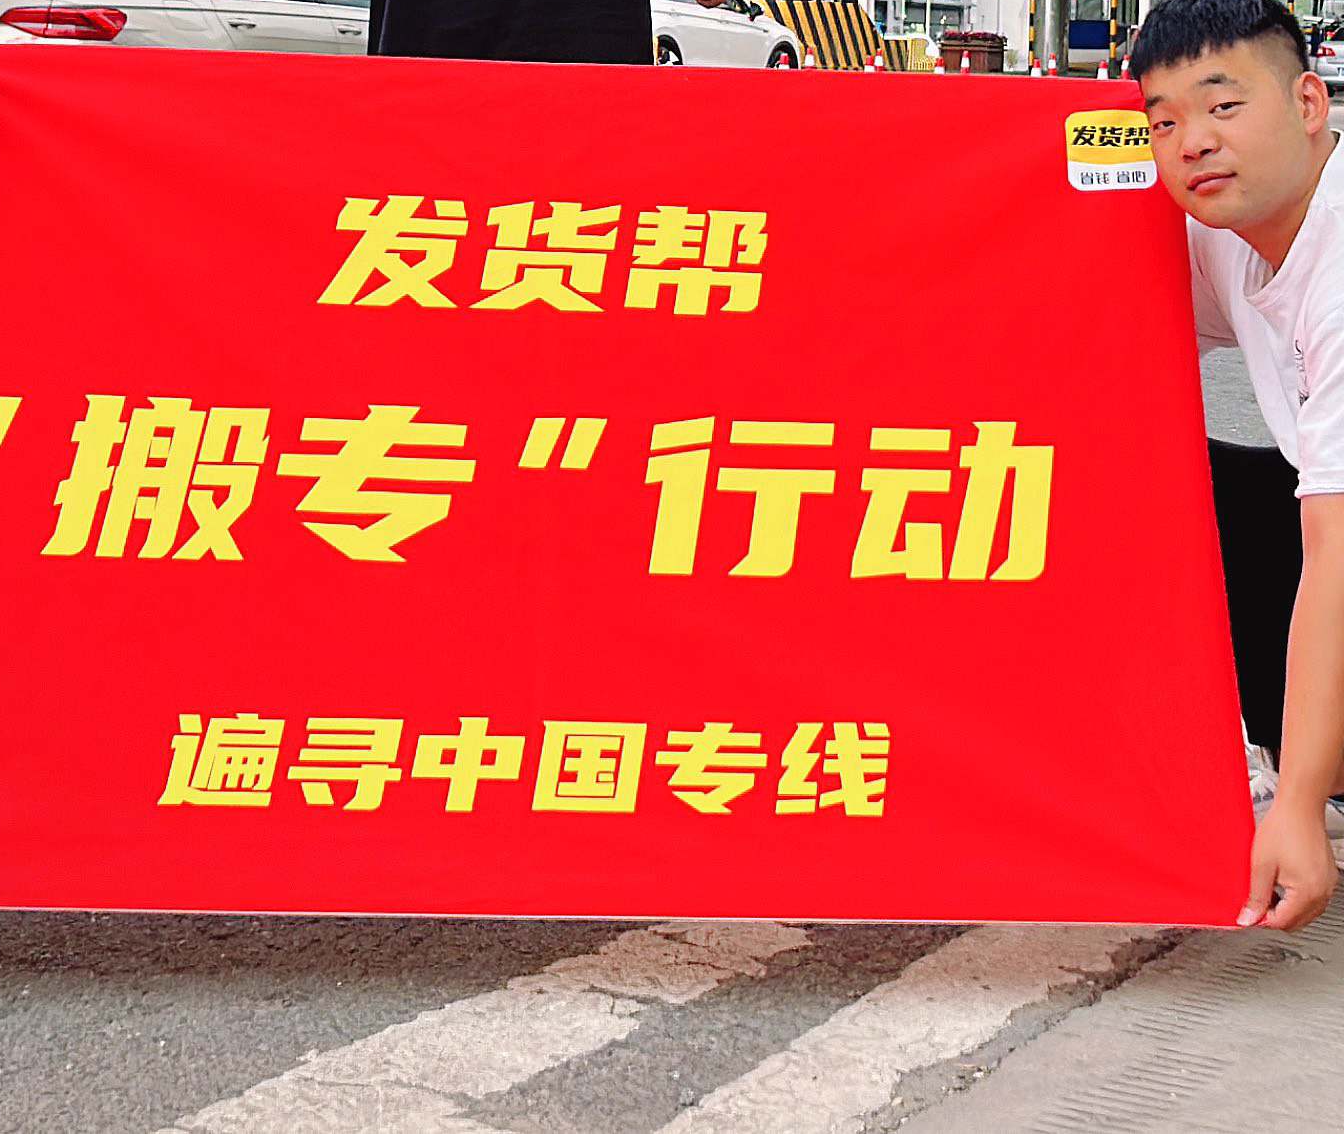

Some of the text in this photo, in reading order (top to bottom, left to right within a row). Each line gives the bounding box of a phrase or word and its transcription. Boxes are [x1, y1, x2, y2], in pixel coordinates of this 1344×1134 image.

[1072, 126, 1151, 147] 发货帮
[1080, 170, 1146, 185] 省钱 省心
[317, 194, 769, 316] 发货帮
[157, 713, 892, 818] 遍寻中国专线
